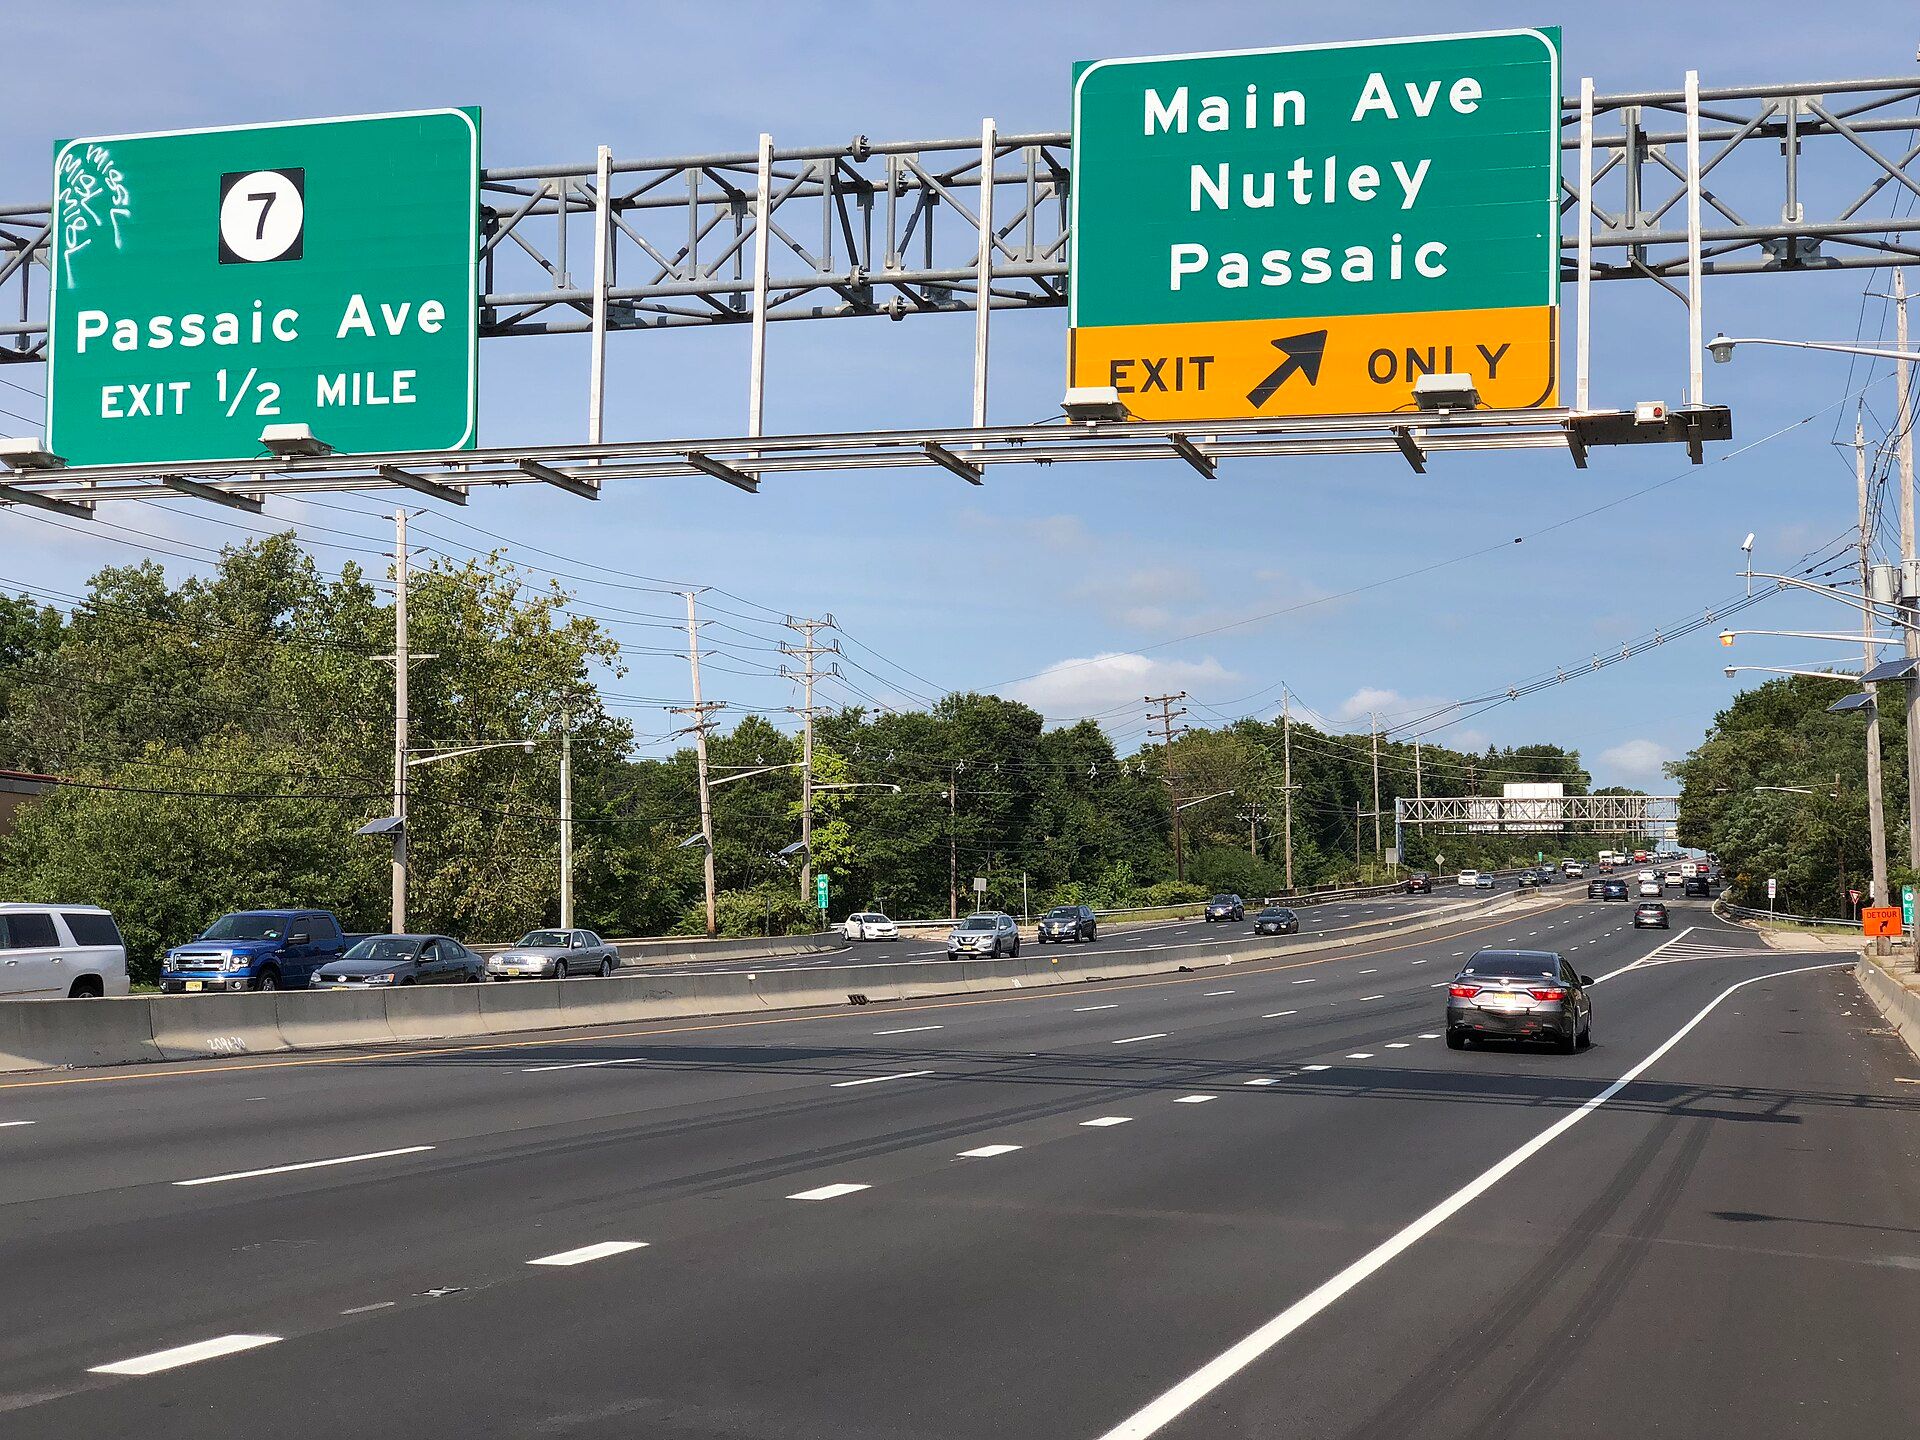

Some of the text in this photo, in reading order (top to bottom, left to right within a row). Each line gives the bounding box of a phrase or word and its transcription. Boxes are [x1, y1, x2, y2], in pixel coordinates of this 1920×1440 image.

[1145, 73, 1483, 136] Main Ave
[1191, 156, 1432, 212] Nutley
[247, 192, 277, 240] 7
[1171, 233, 1448, 291] Passaic
[78, 294, 446, 354] Passaic Ave
[102, 367, 417, 419] EXIT 1/2 MILE
[1110, 356, 1215, 394] EXIT
[1867, 911, 1898, 919] DETOUR
